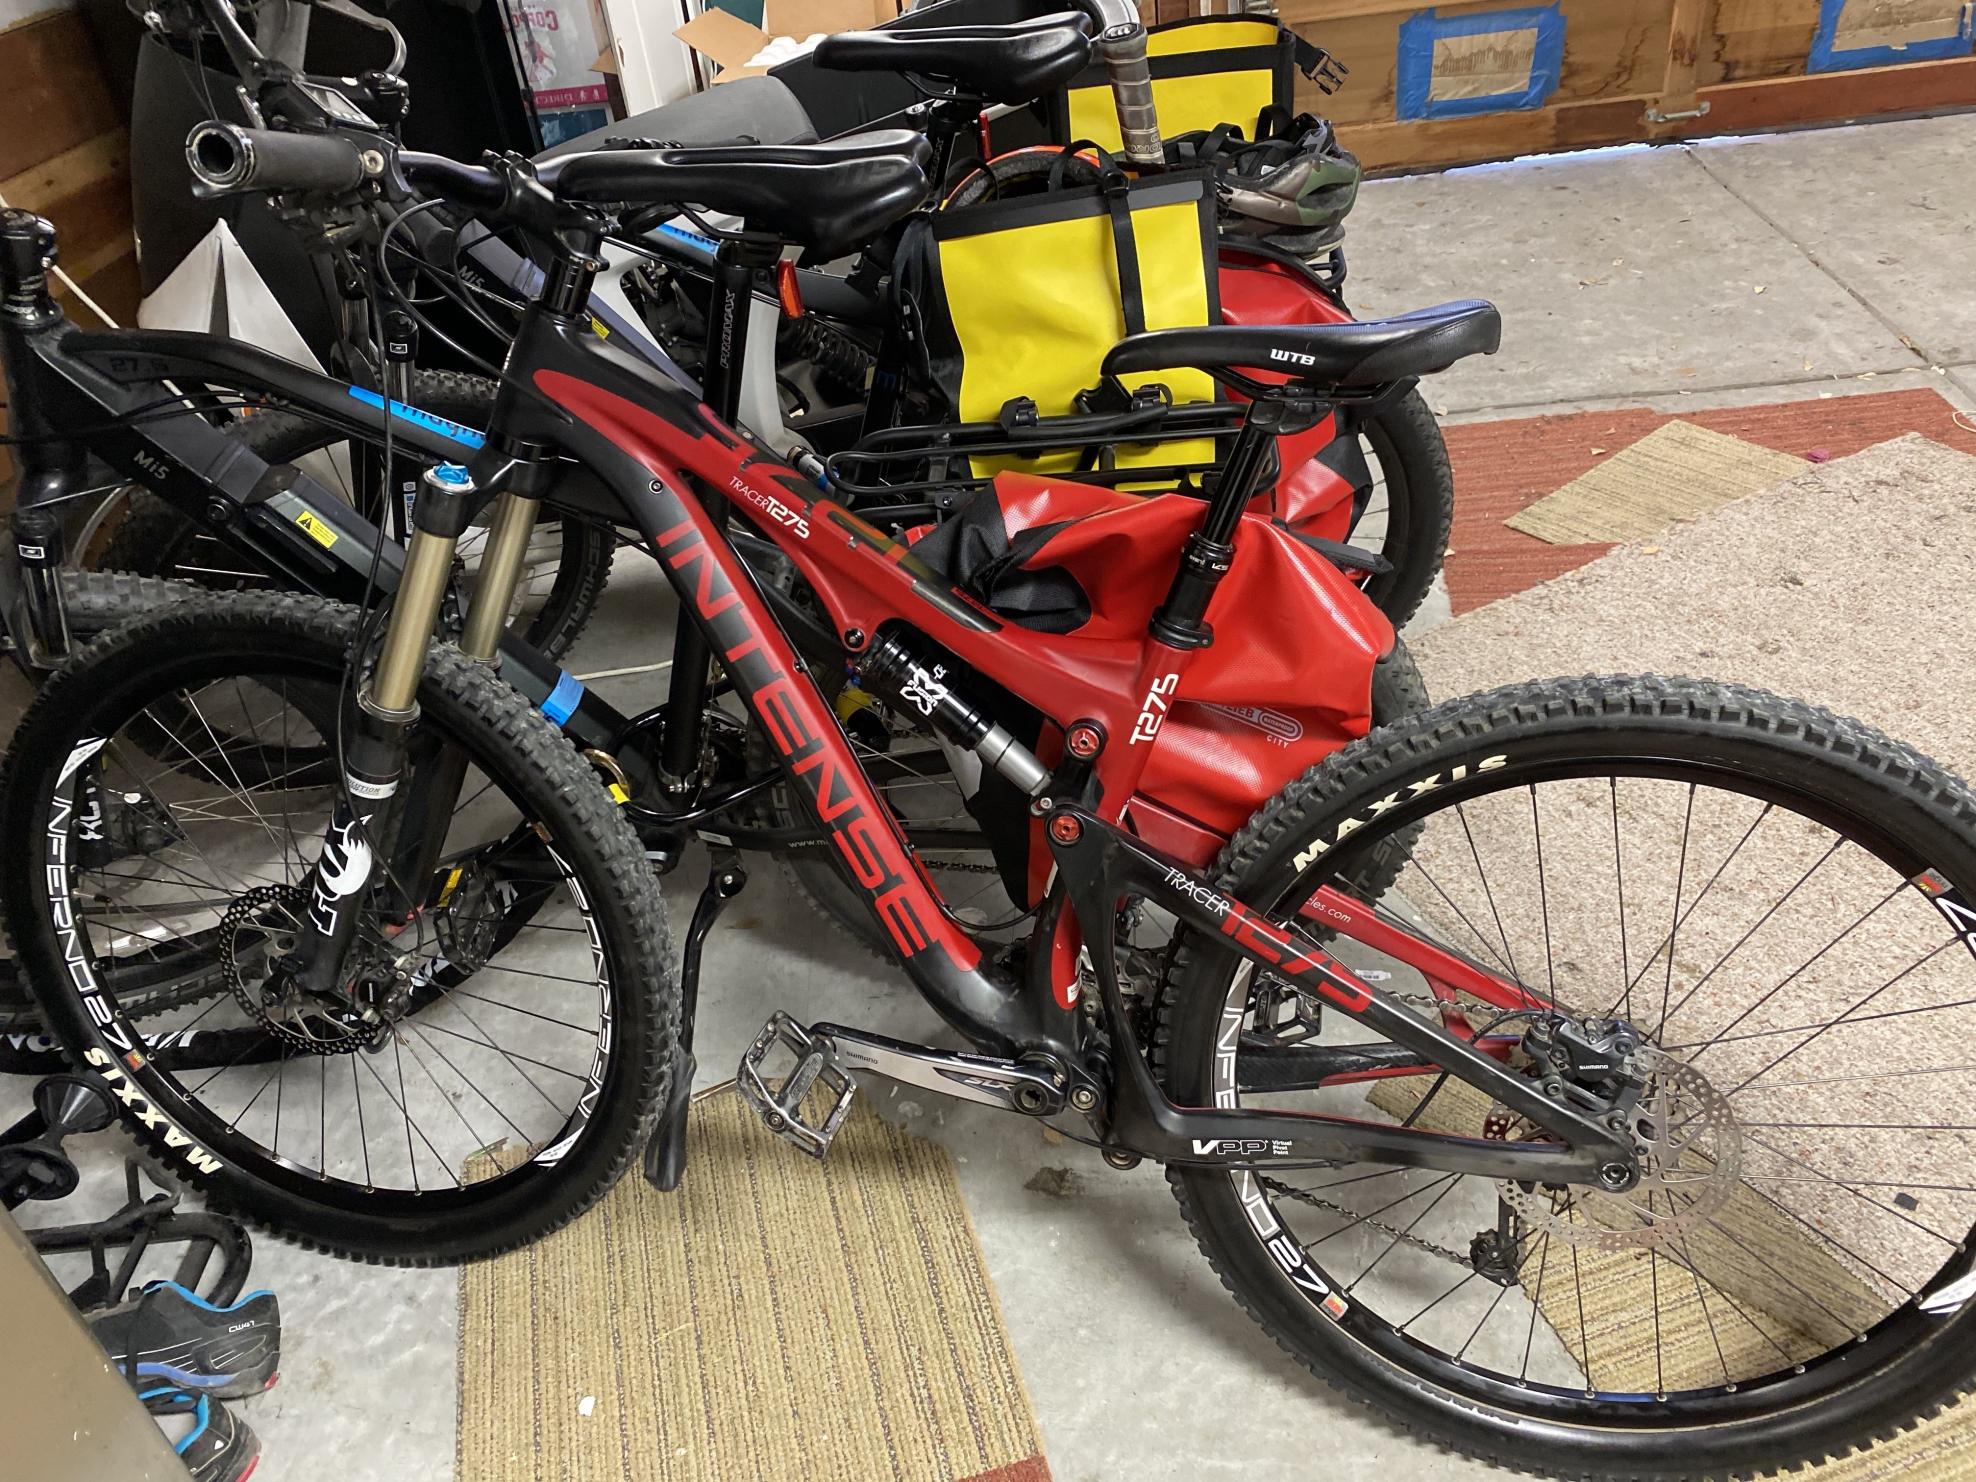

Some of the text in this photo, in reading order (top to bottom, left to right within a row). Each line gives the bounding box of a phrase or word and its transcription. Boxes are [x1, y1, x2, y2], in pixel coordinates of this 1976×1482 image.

[458, 264, 486, 289] Mi5
[719, 288, 736, 369] PROMAX
[1270, 348, 1316, 366] WTB
[133, 449, 170, 480] Mi5
[728, 475, 810, 539] TRACER T275
[1129, 673, 1179, 745] T275
[656, 518, 938, 958] INTENSE
[1266, 734, 1289, 749] CITY
[1292, 754, 1508, 873] MAXXIS
[1164, 866, 1230, 917] TRACER
[846, 1051, 879, 1065] SHIMANO
[964, 1077, 1016, 1091] SLX
[84, 1047, 224, 1175] MAXXIS
[1192, 1139, 1266, 1155] VPP
